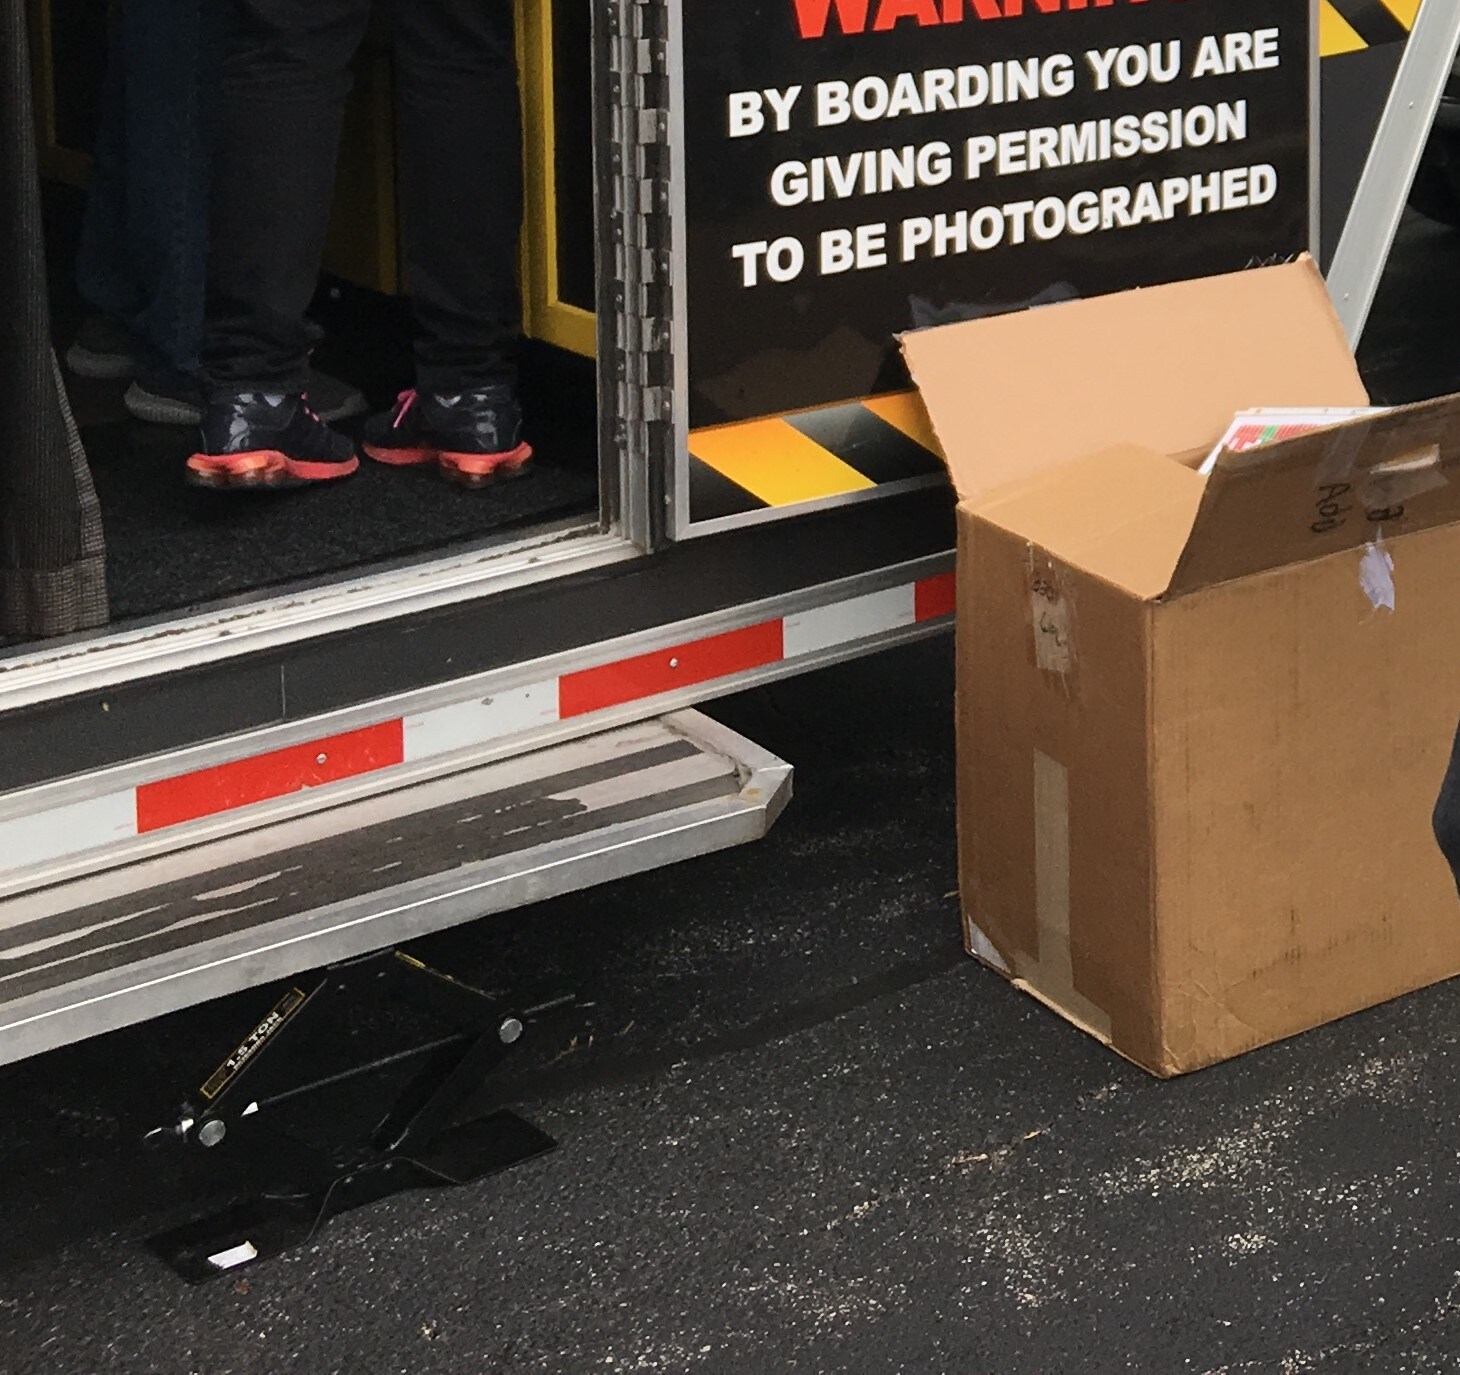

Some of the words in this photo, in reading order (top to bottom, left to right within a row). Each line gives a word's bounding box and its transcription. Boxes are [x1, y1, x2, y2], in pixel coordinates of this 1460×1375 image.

[728, 86, 801, 138] BY
[816, 54, 1075, 127] BOARDING
[1086, 40, 1181, 91] YOU
[1193, 27, 1280, 77] ARE
[769, 141, 952, 207] GIVING
[967, 100, 1247, 180] PERMISSION
[731, 236, 803, 287] TO
[820, 225, 887, 275] BE
[902, 163, 1277, 261] PHOTOGRAPHED
[248, 1011, 279, 1042] TON
